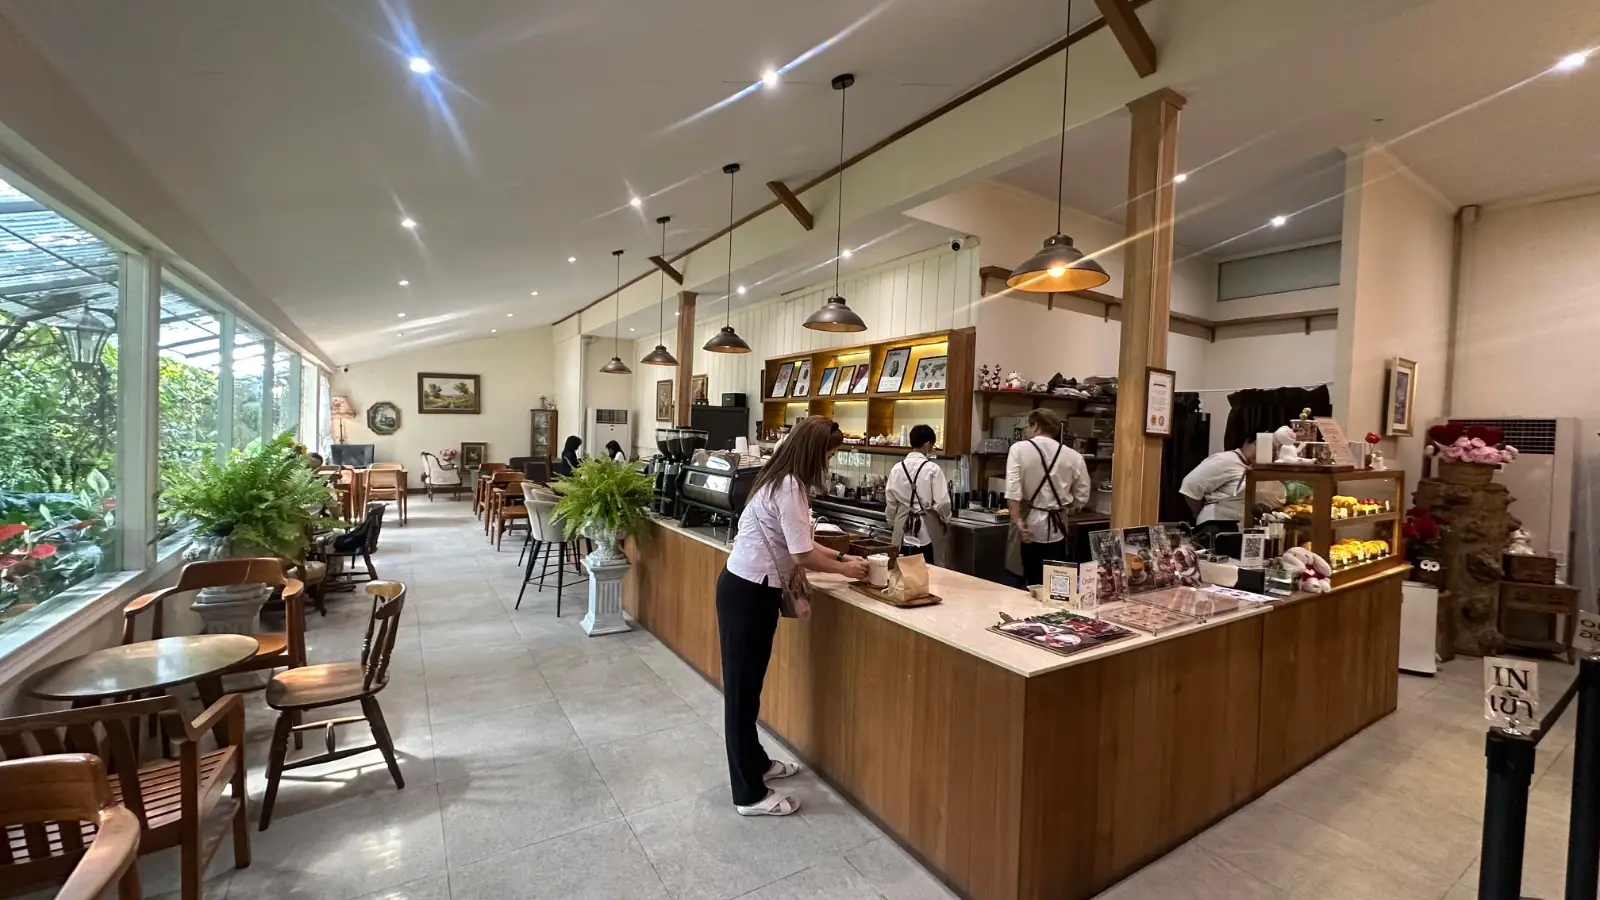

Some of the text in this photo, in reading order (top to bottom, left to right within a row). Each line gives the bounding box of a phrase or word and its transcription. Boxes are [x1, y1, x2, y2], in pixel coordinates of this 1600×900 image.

[1081, 575, 1096, 585] Order
[1492, 665, 1530, 691] IN
[1490, 690, 1533, 719] เข้า
